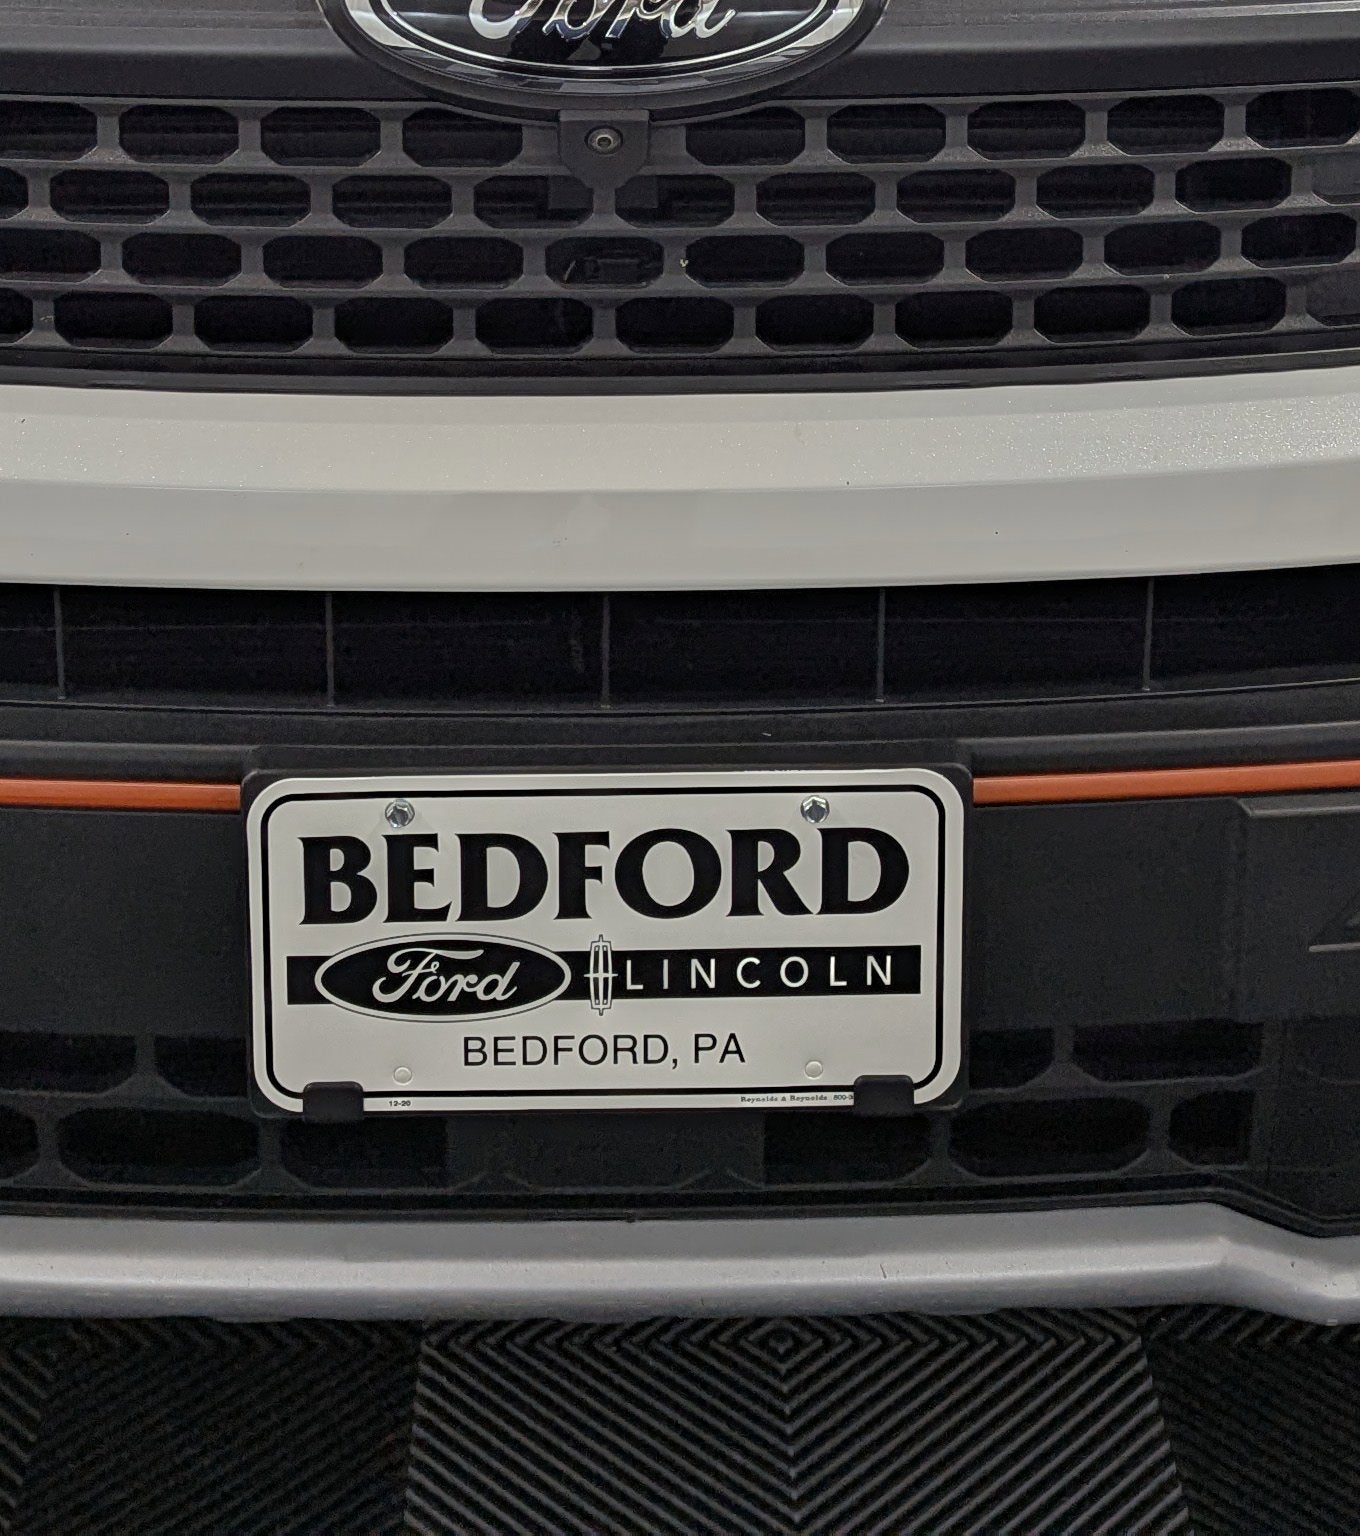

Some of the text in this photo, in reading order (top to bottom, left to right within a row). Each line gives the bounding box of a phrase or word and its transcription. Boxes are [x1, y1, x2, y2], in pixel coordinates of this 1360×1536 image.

[297, 827, 910, 925] BEDFORD
[372, 947, 893, 1004] Ford LINCOLN
[462, 1033, 746, 1070] BEDFORD, PA
[388, 1099, 412, 1107] 12-20
